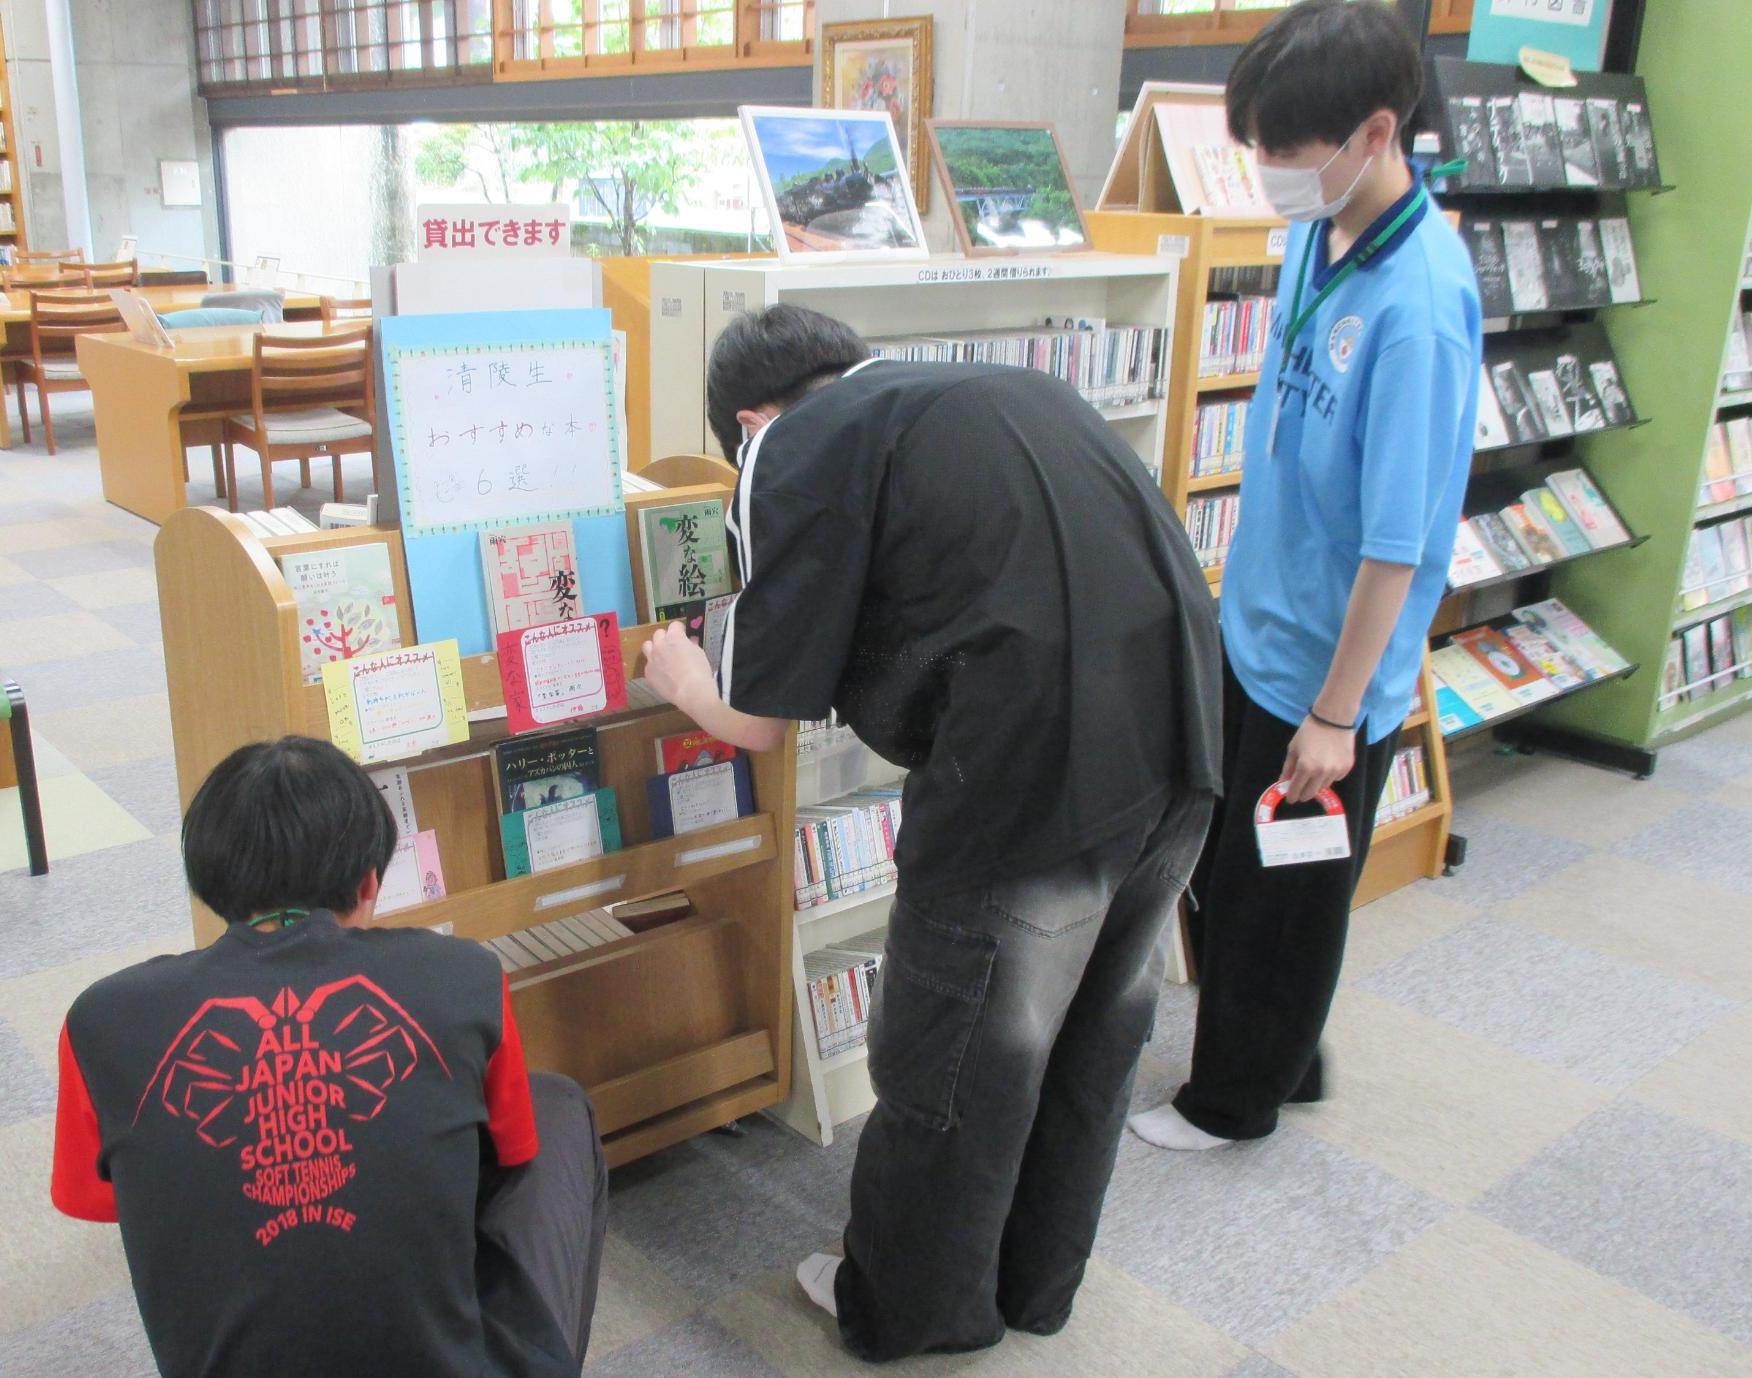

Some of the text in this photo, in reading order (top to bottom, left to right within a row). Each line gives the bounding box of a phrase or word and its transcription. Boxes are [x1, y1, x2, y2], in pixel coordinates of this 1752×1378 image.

[422, 218, 566, 249] 貸出できます
[447, 360, 553, 396] 清陵生
[427, 412, 582, 448] おすすめな本
[675, 514, 706, 598] 変な絵
[506, 746, 595, 770] ハリー・ポッターと
[255, 1024, 320, 1059] ALL
[234, 1051, 342, 1092] JAPAN
[243, 1079, 345, 1124] JUNIOR
[258, 1102, 327, 1142] HIGH
[240, 1128, 353, 1171] SCHOOL
[242, 1162, 357, 1208] CHAMPIONSHIPS
[254, 1154, 342, 1188] SOFT TENNIS
[255, 1205, 357, 1246] 2018 IN ISE
